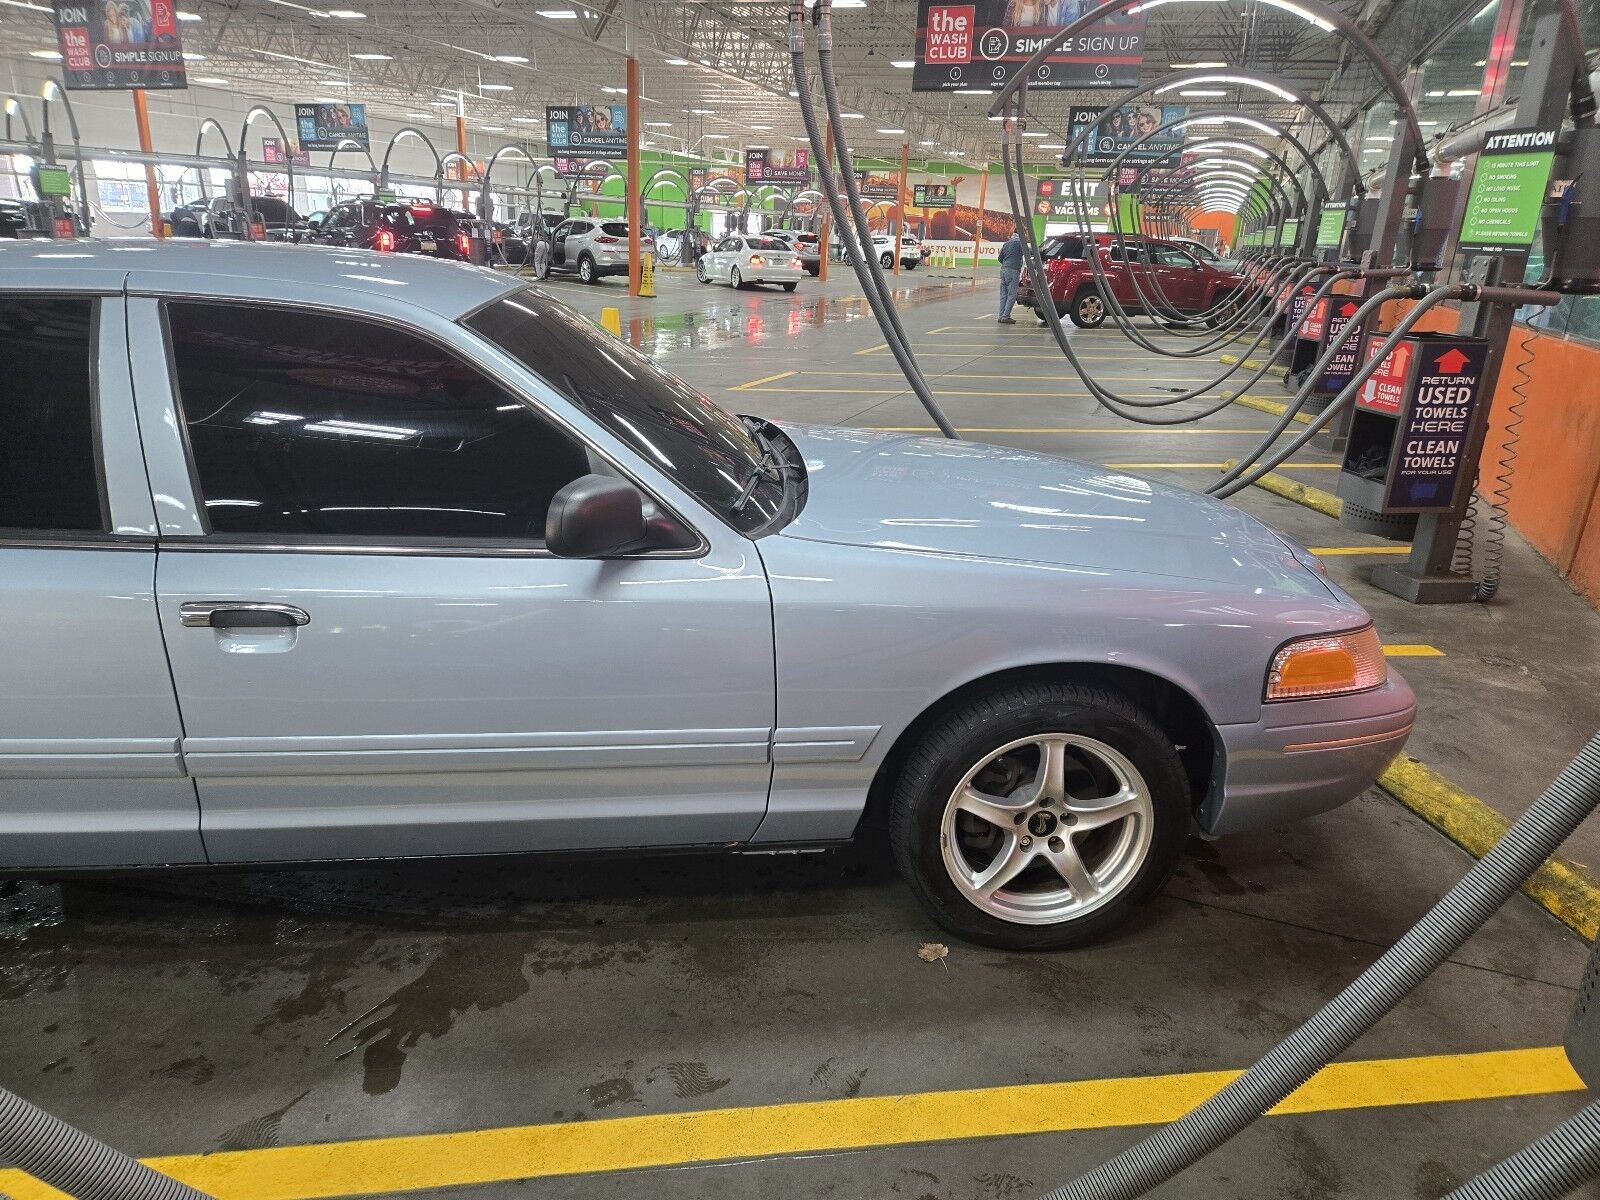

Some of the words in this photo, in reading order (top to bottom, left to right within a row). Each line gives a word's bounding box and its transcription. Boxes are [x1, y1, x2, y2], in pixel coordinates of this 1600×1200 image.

[60, 8, 87, 22] JOIN
[932, 10, 968, 32] the
[64, 31, 86, 46] the
[930, 34, 968, 45] WASH
[1078, 38, 1114, 51] SIGN
[1119, 36, 1138, 50] UP
[114, 52, 146, 62] SIMPLE
[148, 52, 168, 61] SIGN
[170, 51, 180, 60] UP
[929, 46, 967, 59] CLUB
[68, 58, 91, 66] CLUB
[550, 111, 568, 119] JOIN
[1074, 112, 1101, 122] JOIN
[301, 120, 312, 128] the
[552, 124, 565, 132] the
[1485, 131, 1555, 149] ATTENTION
[1422, 376, 1475, 384] RETURN
[1379, 383, 1401, 395] CLEAN
[1377, 392, 1400, 403] TOWELS
[1418, 387, 1471, 404] USED
[1416, 407, 1468, 418] TOWELS
[1410, 421, 1464, 432] HERE
[1407, 441, 1459, 454] CLEAN
[1404, 457, 1456, 468] TOWELS
